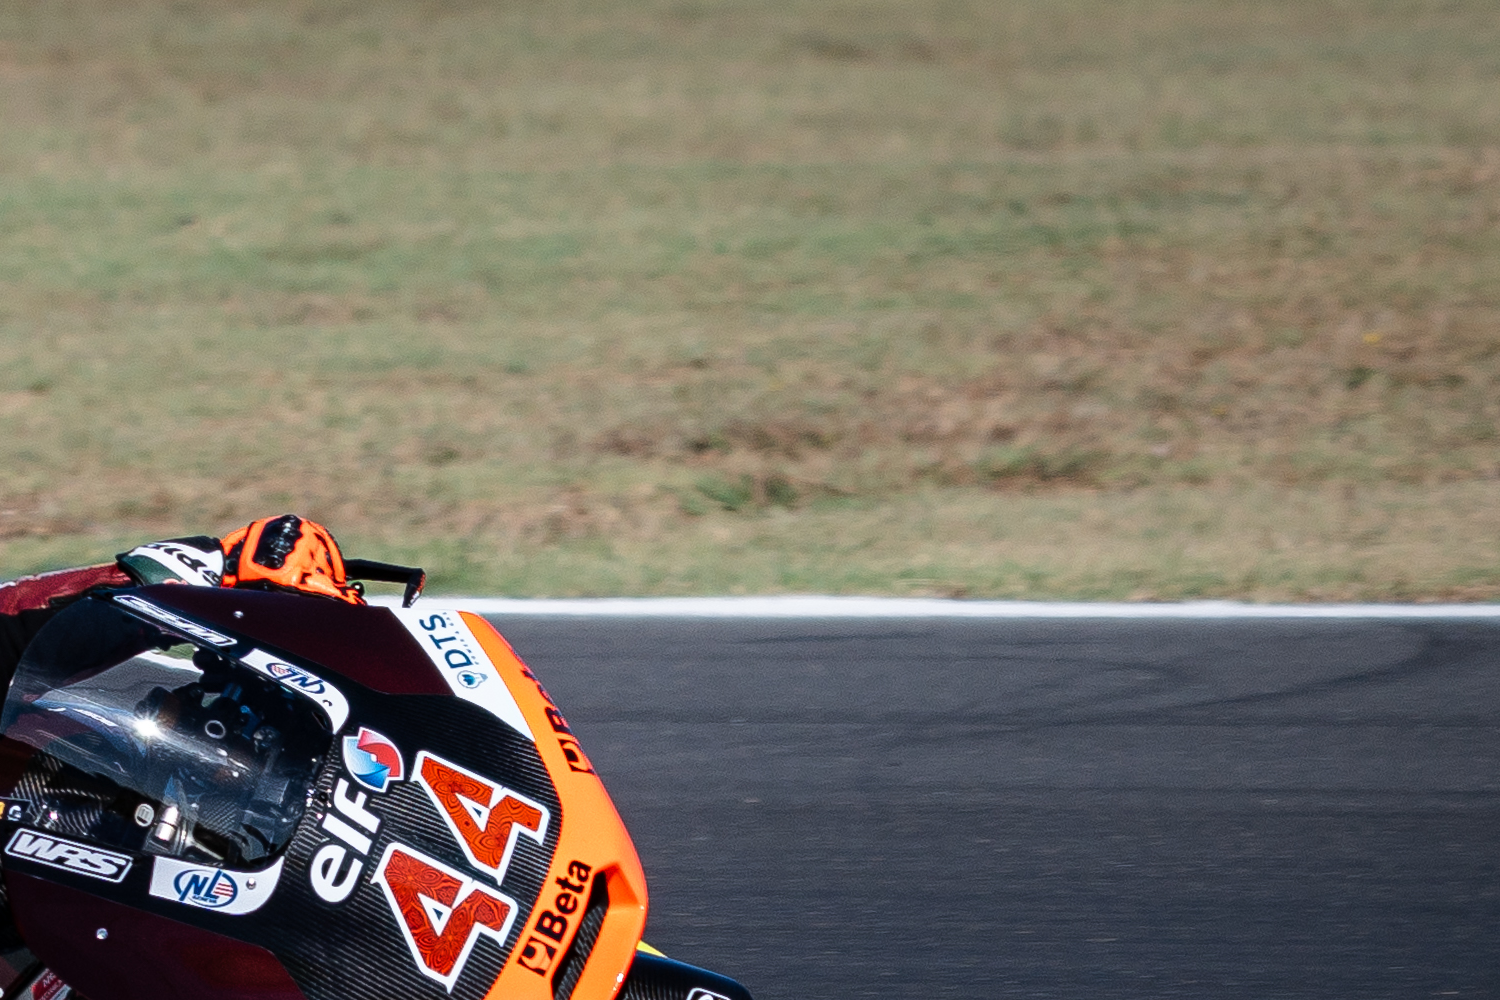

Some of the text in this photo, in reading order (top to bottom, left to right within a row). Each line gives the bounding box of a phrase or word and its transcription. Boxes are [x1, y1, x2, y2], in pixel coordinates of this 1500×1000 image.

[419, 614, 474, 669] DTS
[12, 834, 127, 877] WRS
[310, 777, 383, 903] elf
[371, 751, 550, 993] 44
[535, 859, 593, 941] Beta
